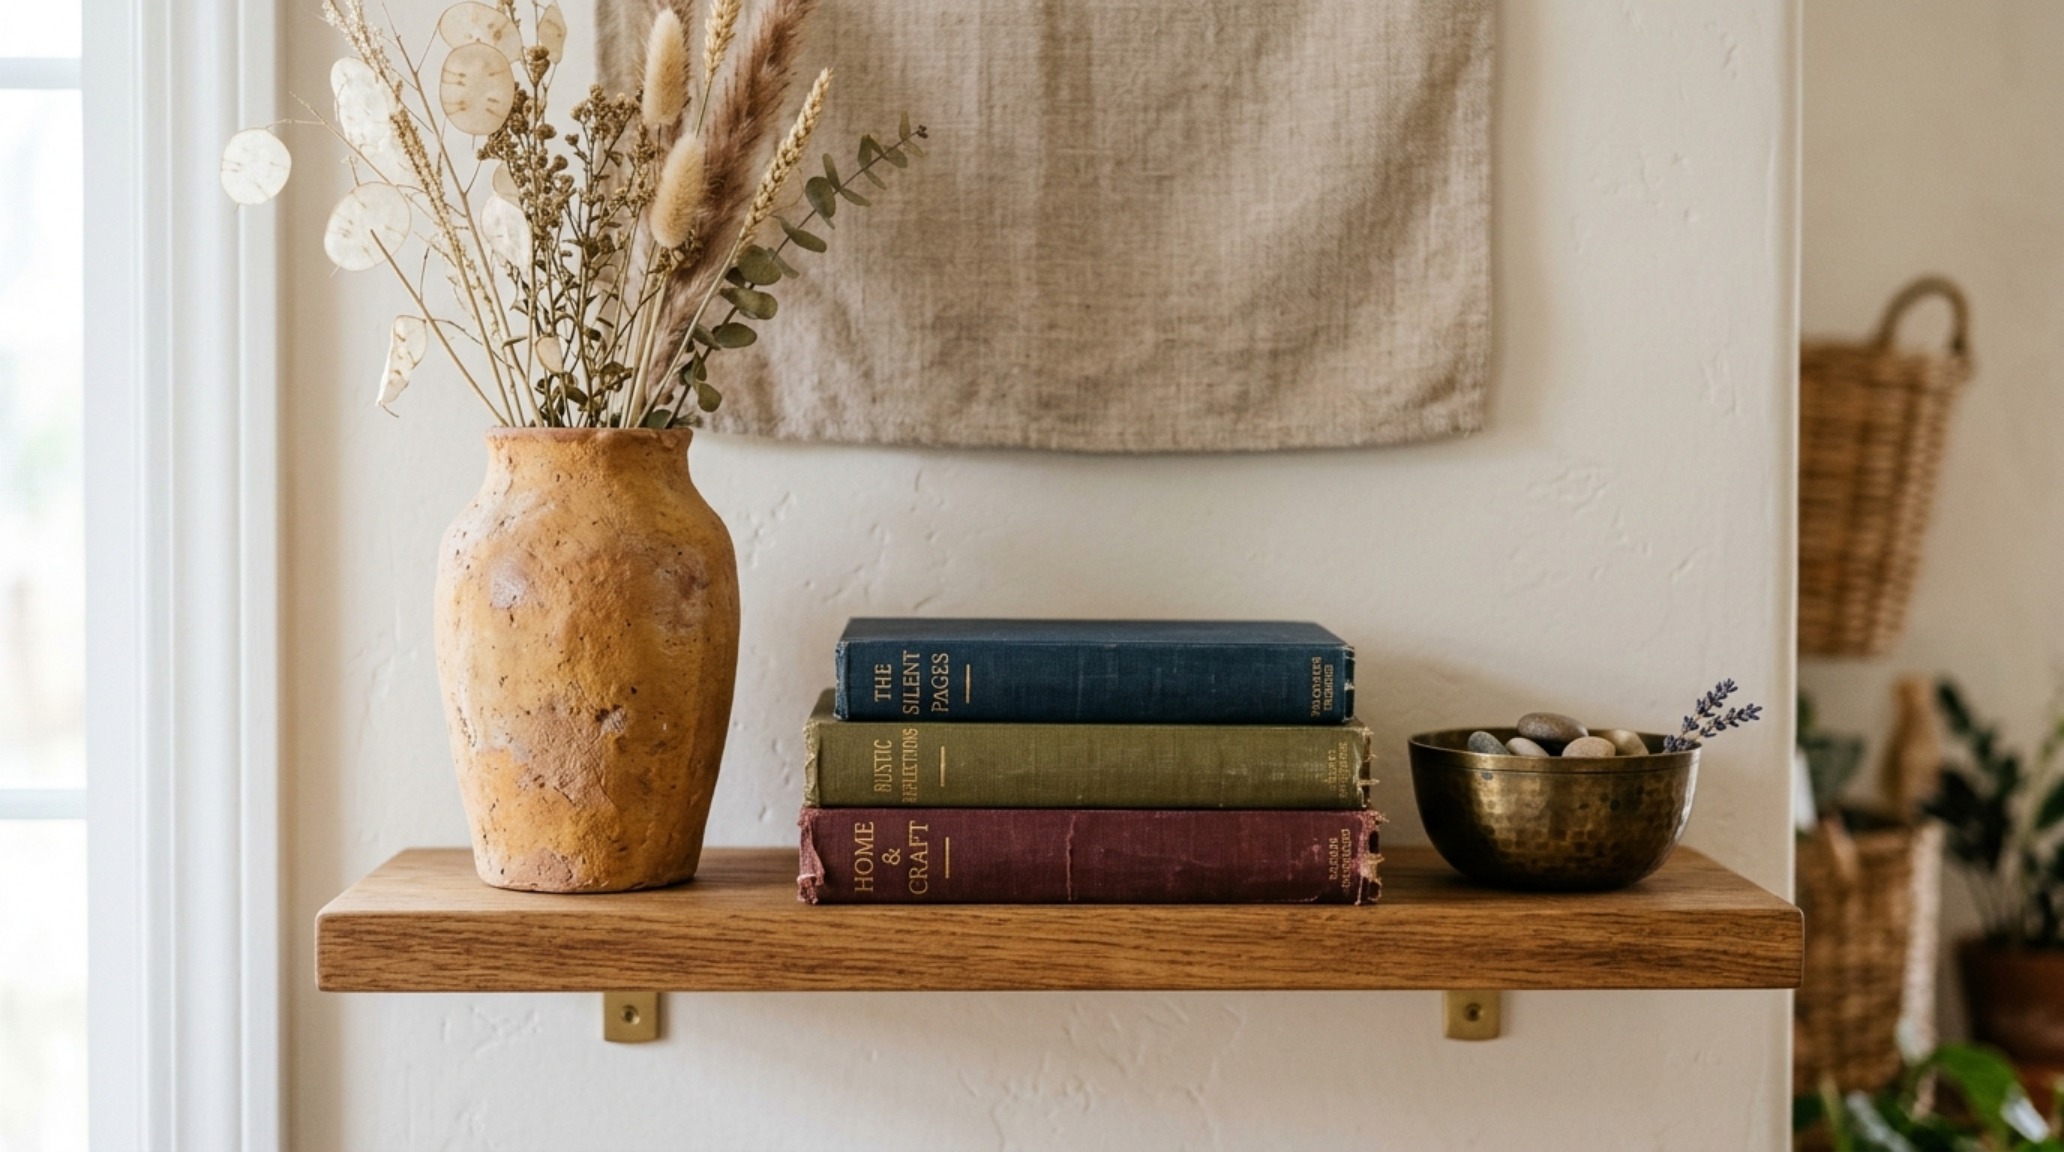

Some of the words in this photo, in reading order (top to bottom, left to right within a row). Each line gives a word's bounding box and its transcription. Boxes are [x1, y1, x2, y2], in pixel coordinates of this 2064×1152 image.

[874, 663, 892, 703] THE
[902, 650, 921, 715] SILENT
[931, 653, 949, 712] PAGES
[854, 821, 874, 893] HOME
[881, 848, 901, 866] &
[908, 820, 929, 895] CRAFT
